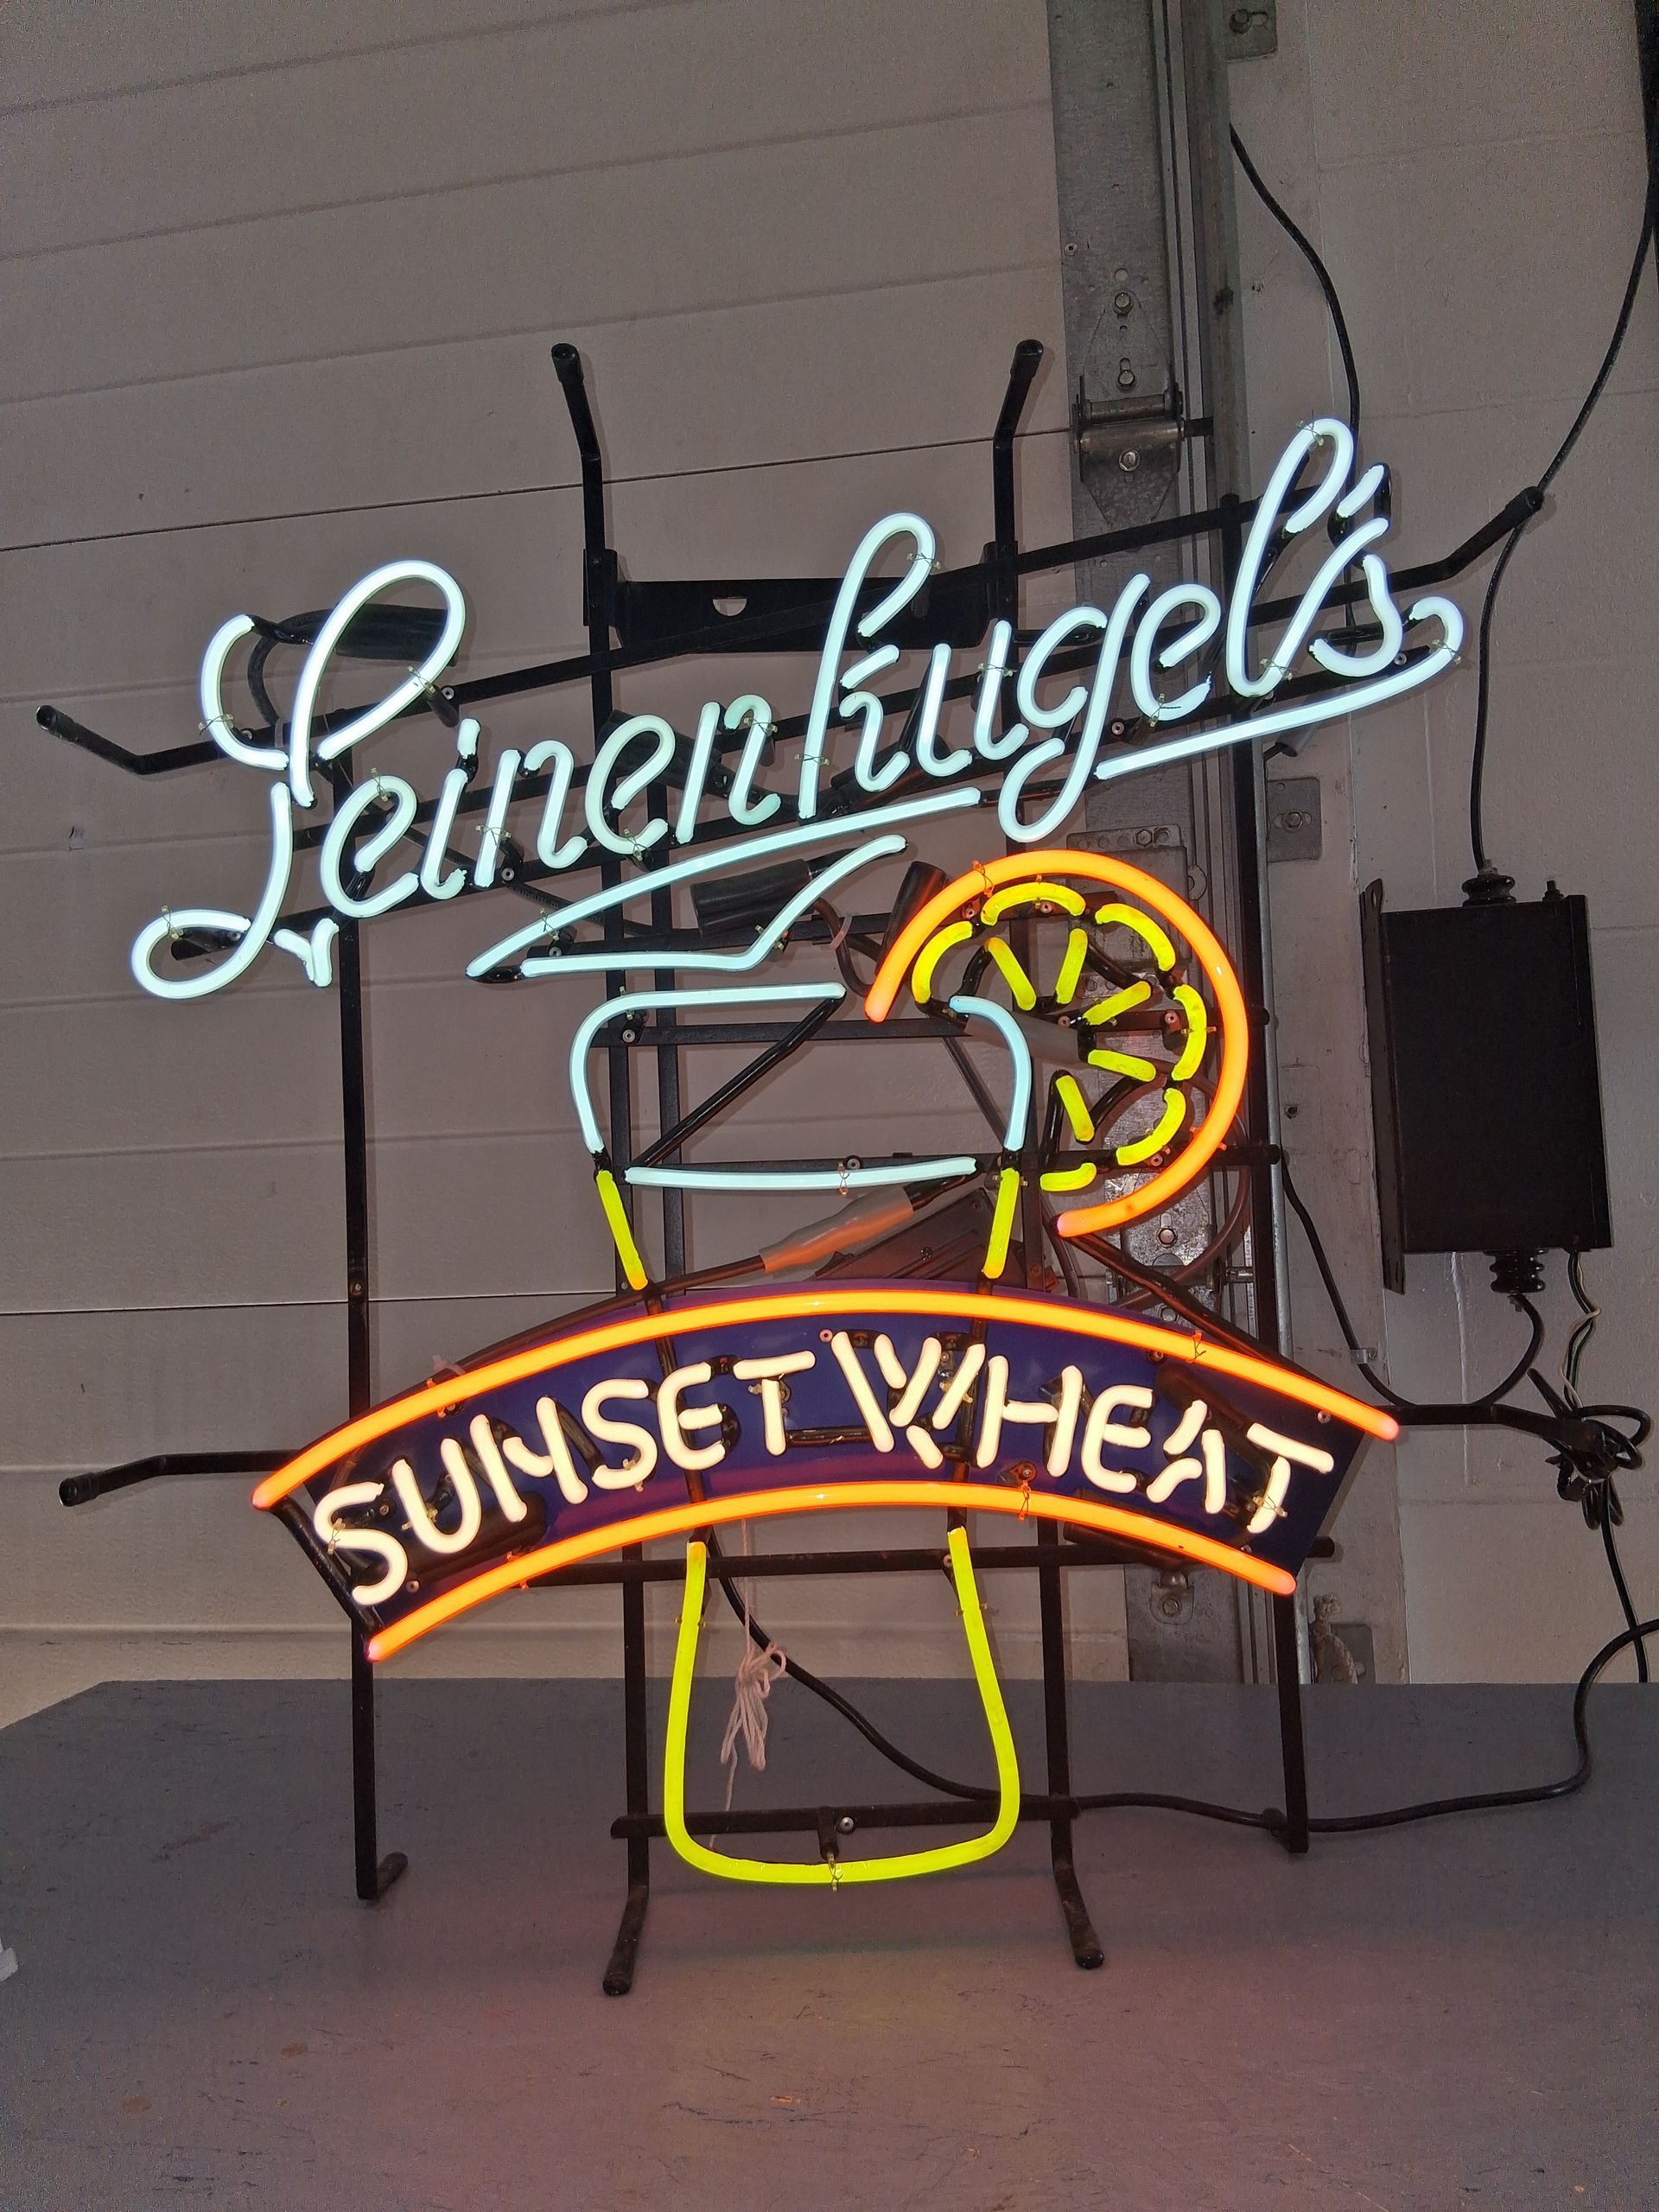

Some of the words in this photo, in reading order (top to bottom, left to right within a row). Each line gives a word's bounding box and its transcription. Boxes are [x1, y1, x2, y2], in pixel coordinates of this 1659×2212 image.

[131, 417, 1464, 1000] Leinenkugel's
[314, 1350, 816, 1605] SUNSET
[831, 1331, 1334, 1534] WHEAT
